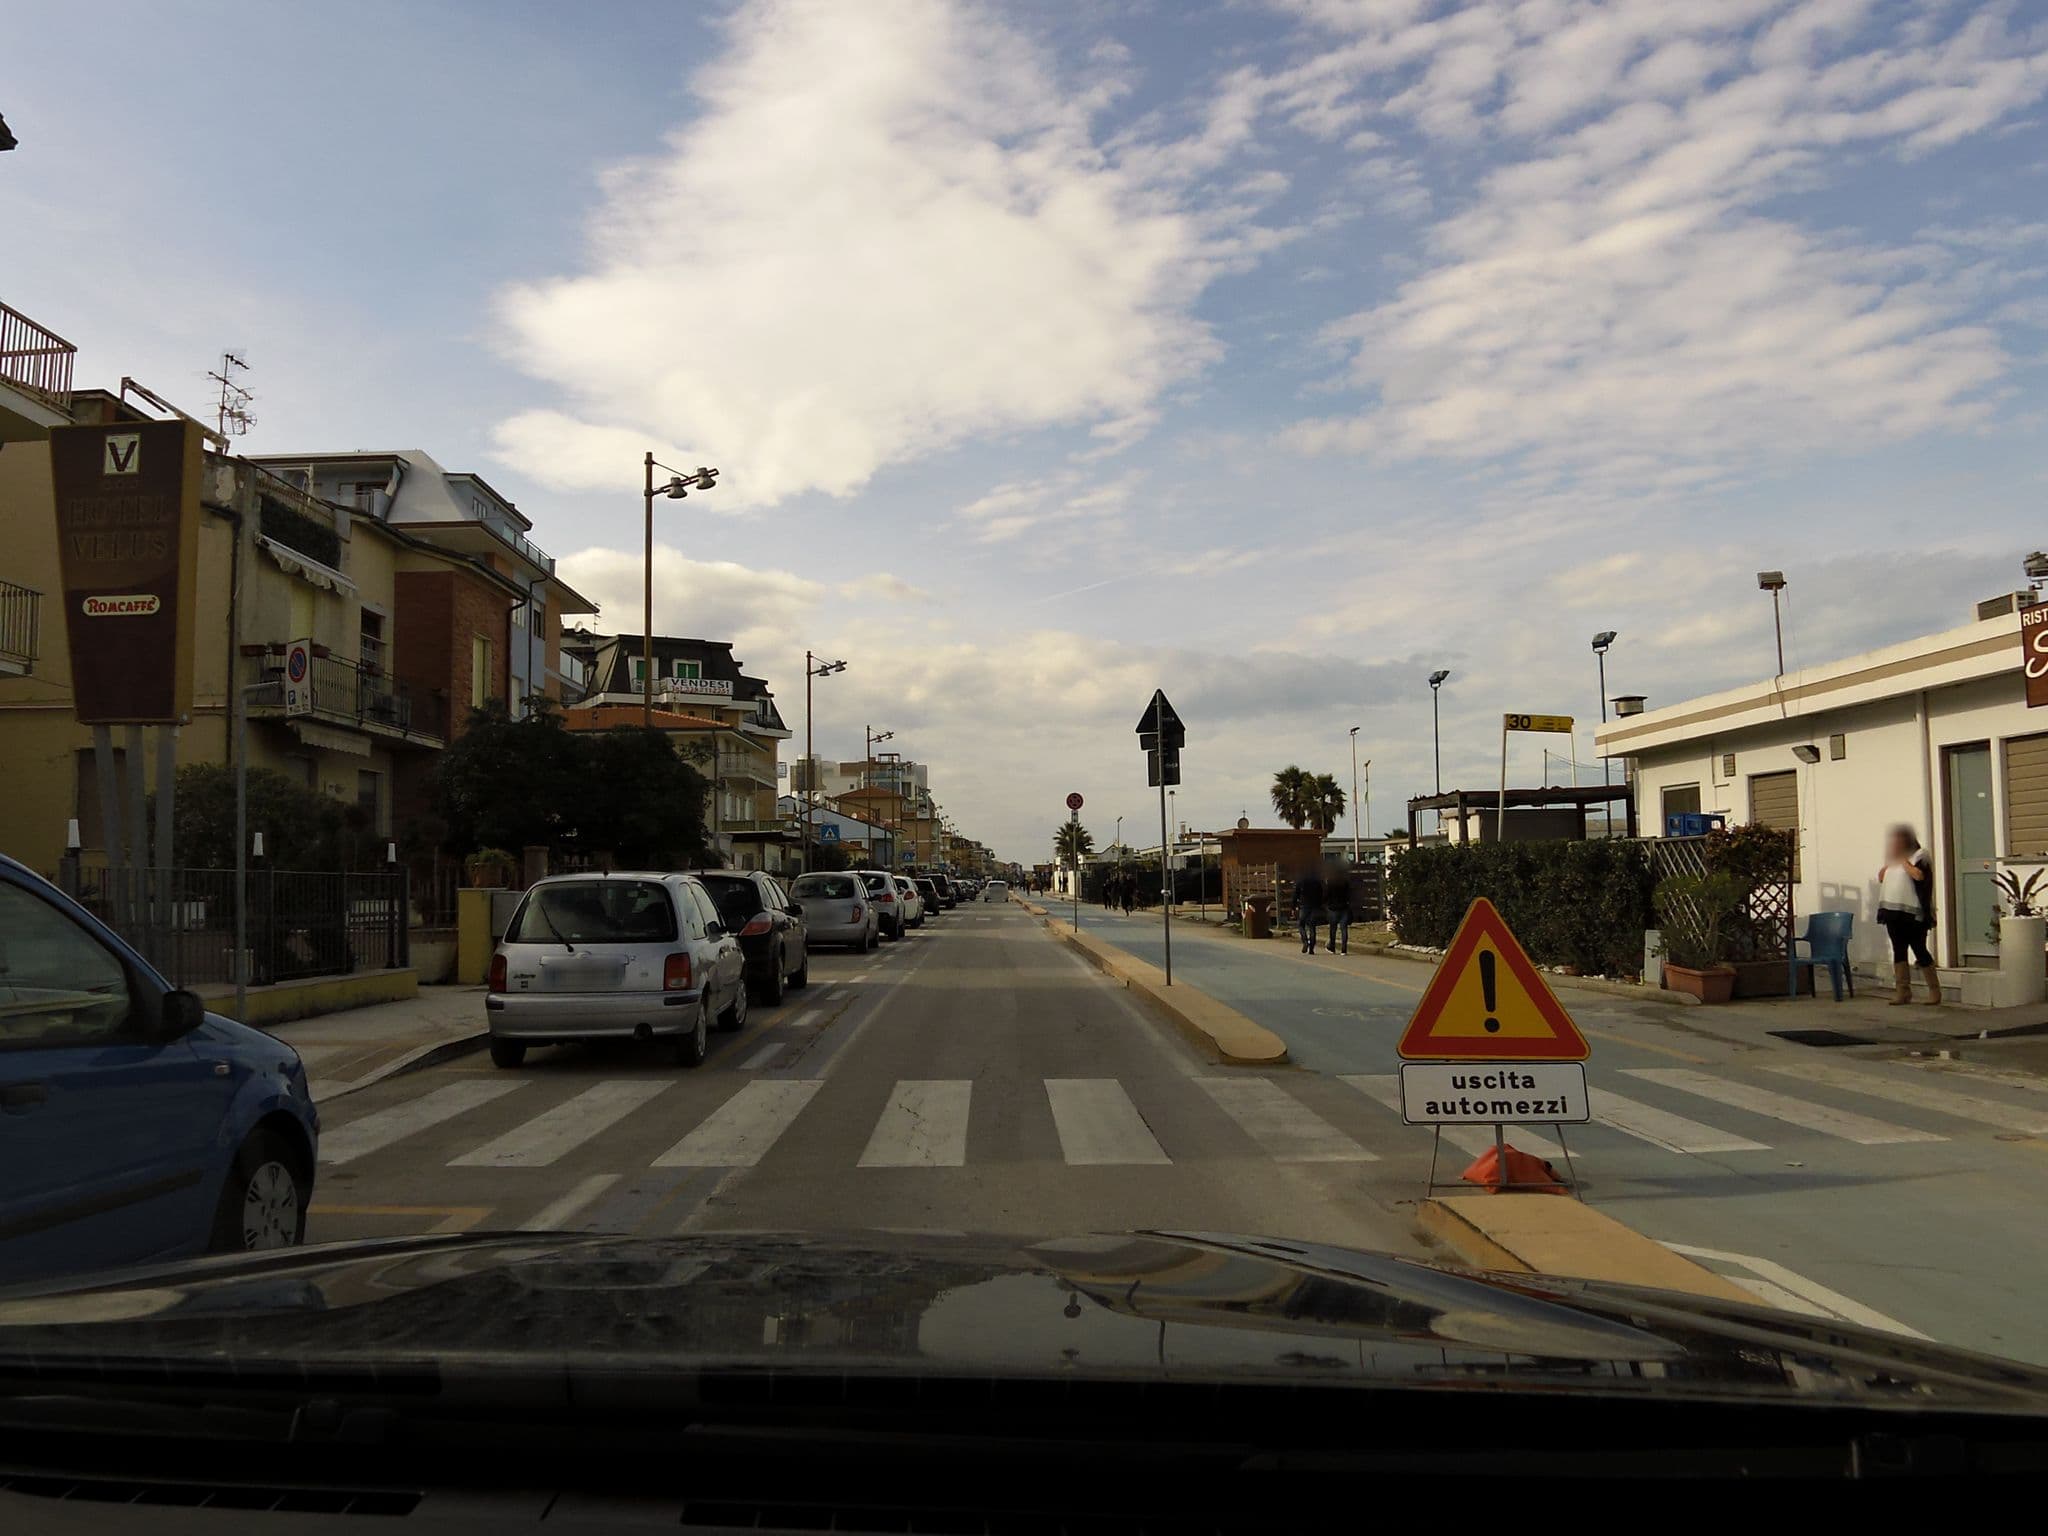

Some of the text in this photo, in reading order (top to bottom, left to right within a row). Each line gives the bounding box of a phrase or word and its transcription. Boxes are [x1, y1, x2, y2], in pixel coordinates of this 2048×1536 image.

[108, 441, 138, 471] V
[2022, 608, 2048, 627] RIST
[671, 678, 729, 689] VENDESI
[1508, 714, 1531, 729] 30
[1452, 1071, 1536, 1090] uscita
[1426, 1096, 1568, 1115] automezzi
